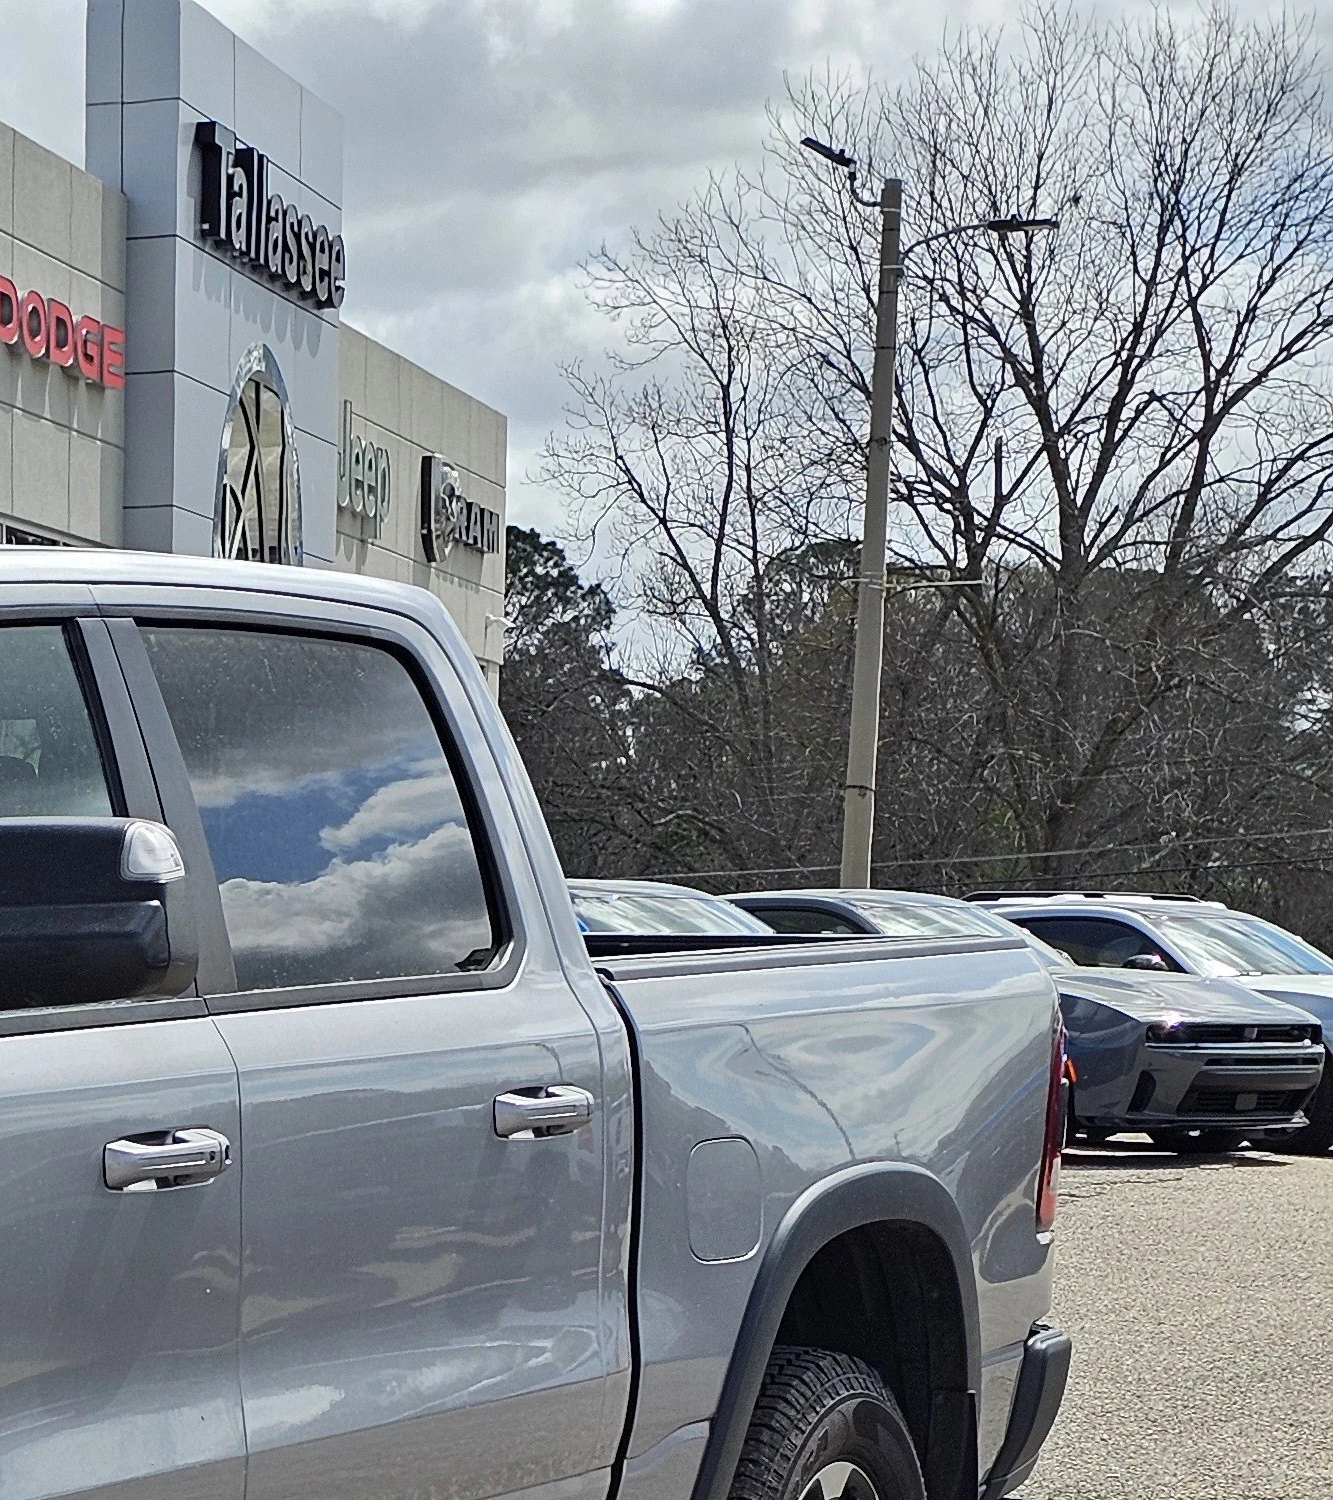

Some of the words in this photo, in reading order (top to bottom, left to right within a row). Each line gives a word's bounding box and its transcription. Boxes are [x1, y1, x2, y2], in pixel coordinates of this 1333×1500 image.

[212, 121, 345, 309] Tallassee
[337, 399, 391, 540] Jeep
[454, 494, 499, 554] RAM
